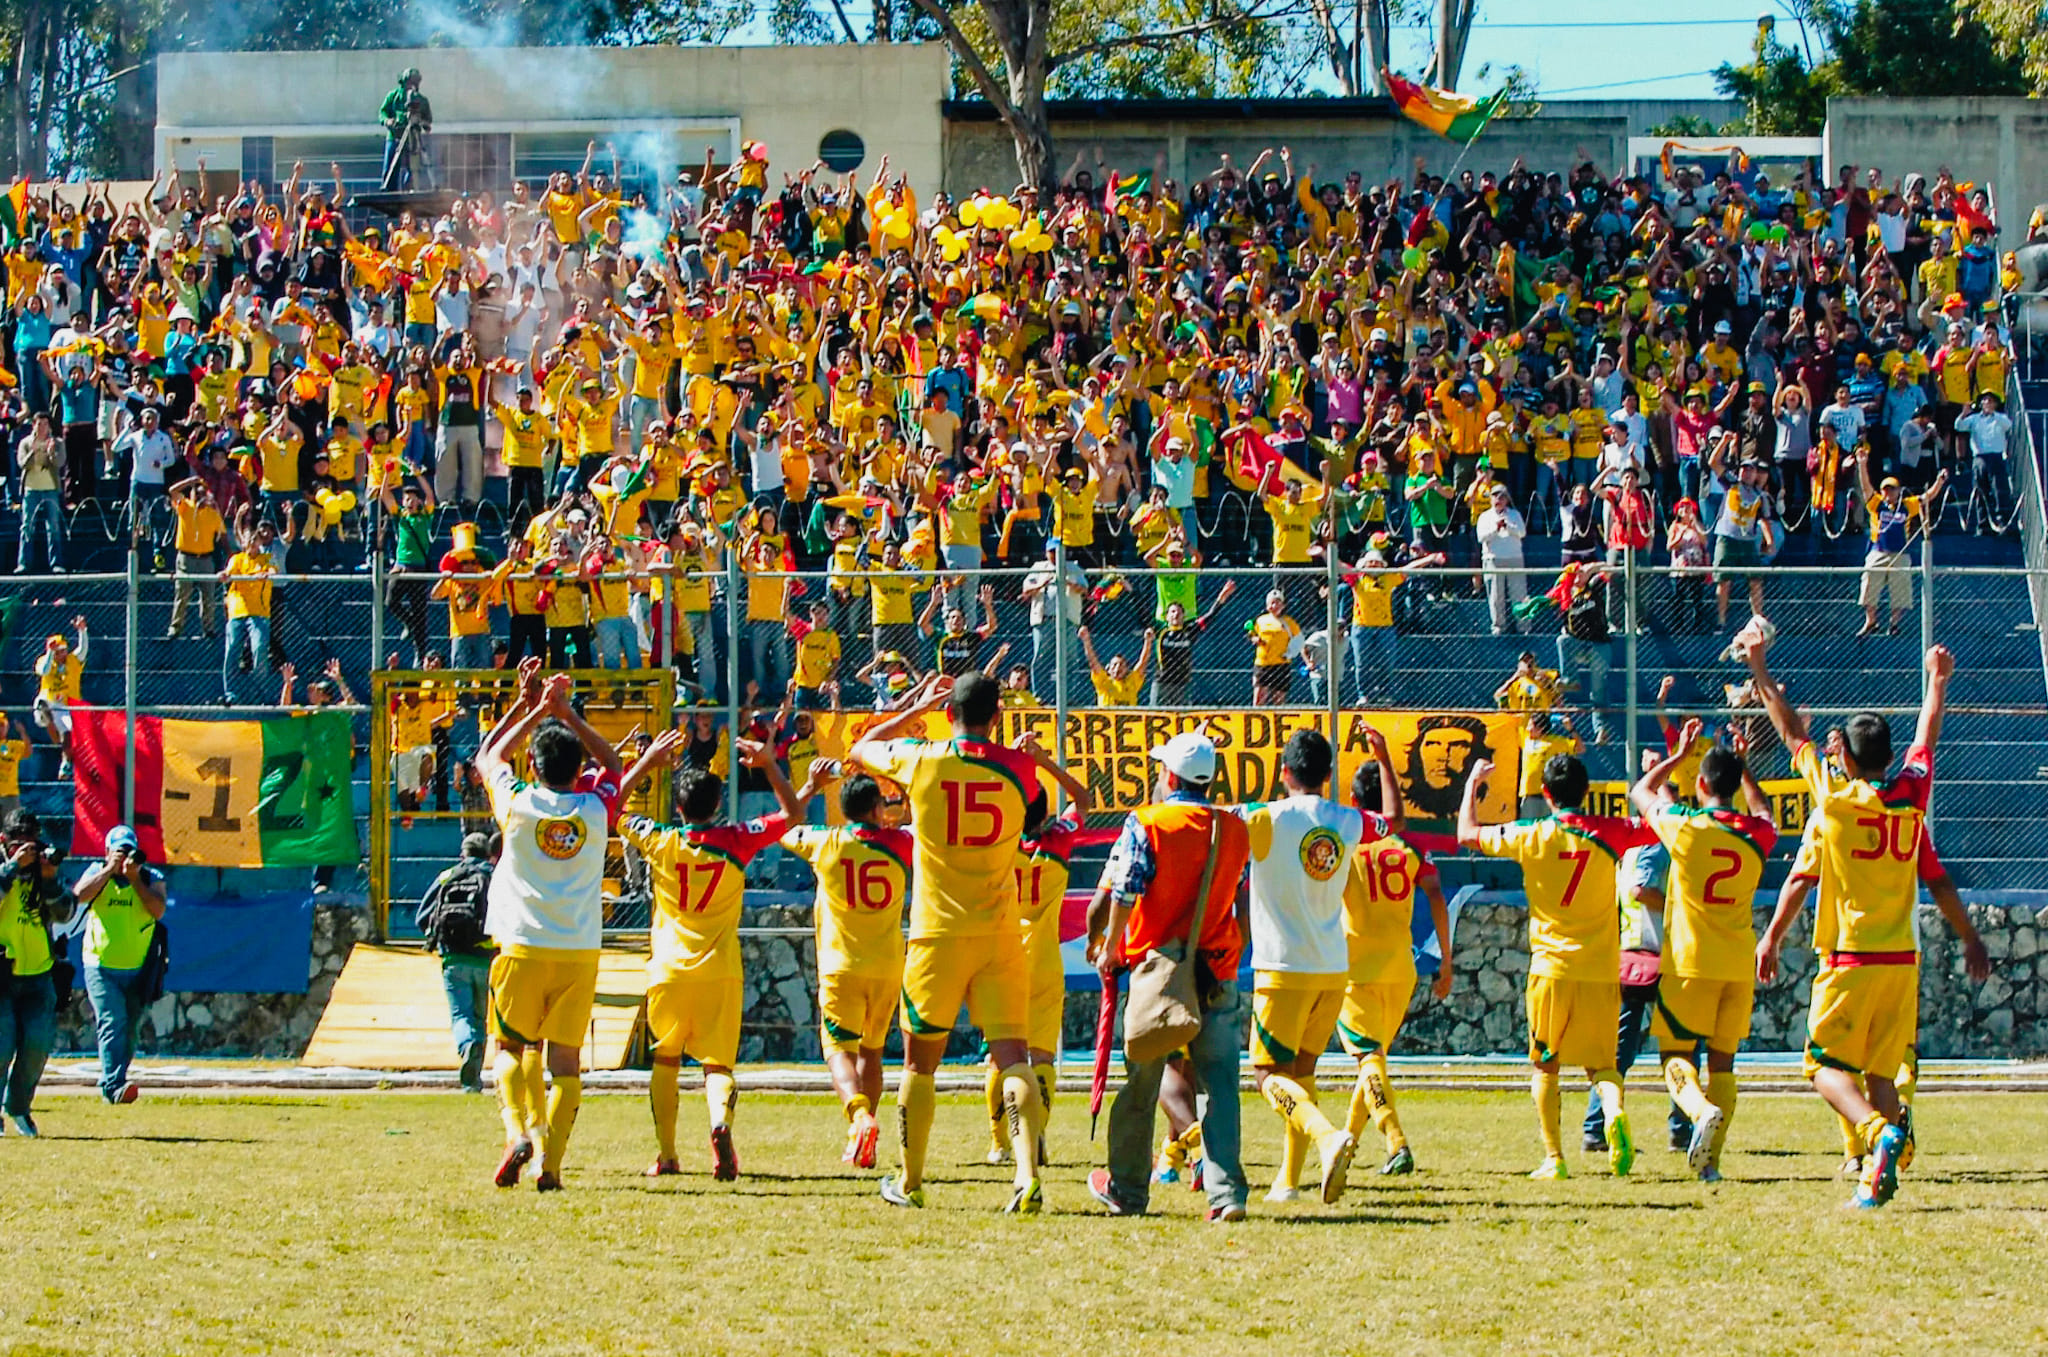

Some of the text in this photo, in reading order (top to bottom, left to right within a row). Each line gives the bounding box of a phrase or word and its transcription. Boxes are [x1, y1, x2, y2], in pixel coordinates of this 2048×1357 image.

[1244, 713, 1300, 749] DE
[940, 780, 1004, 847] 15
[1852, 811, 1920, 862] 30
[675, 861, 727, 913] 17
[840, 858, 892, 910] 16
[1359, 849, 1411, 902] 18
[1558, 849, 1591, 907] 7
[1703, 848, 1743, 905] 2
